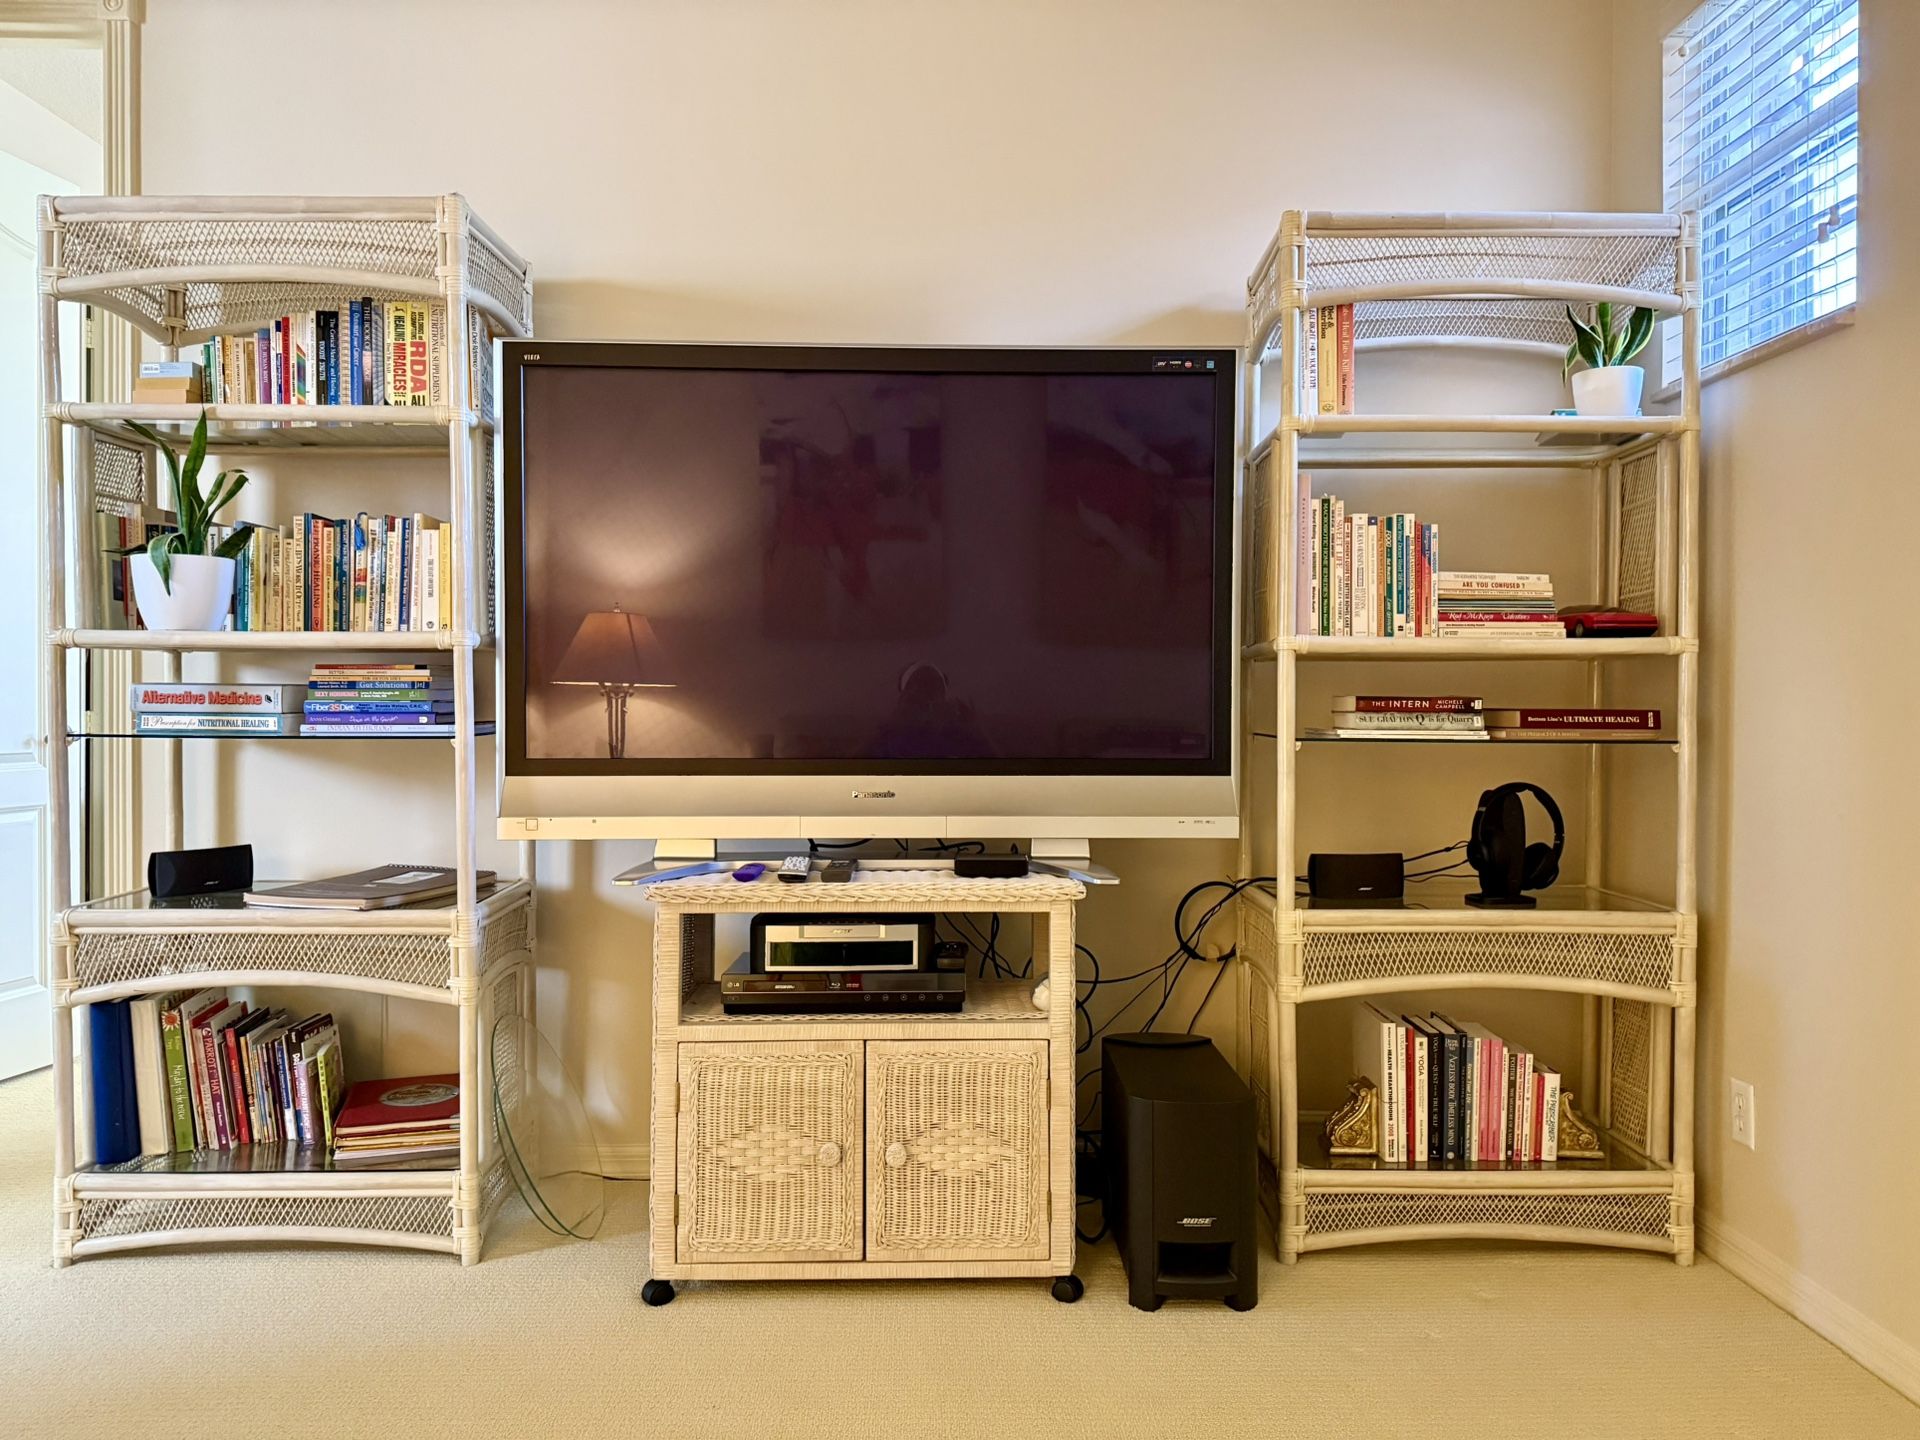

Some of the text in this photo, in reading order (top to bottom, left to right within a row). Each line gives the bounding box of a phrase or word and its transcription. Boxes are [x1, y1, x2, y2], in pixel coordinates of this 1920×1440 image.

[363, 306, 371, 321] THE
[363, 321, 372, 340] BOOK
[393, 315, 407, 391] HEALING MIRACLES
[431, 308, 441, 402] NUTRITIONAL SUPPLEMENTS
[410, 340, 427, 394] RDA
[313, 570, 321, 609] HEALING
[375, 681, 408, 689] Solutions
[141, 690, 262, 705] Alternative Medicine
[1389, 700, 1430, 708] INTERN
[151, 716, 270, 729] Prescription for NUTRITIONAL HEALING
[1415, 713, 1425, 725] Q
[1436, 714, 1447, 722] for
[1447, 714, 1475, 724] Quarry
[851, 790, 896, 799] Panasonic
[203, 1037, 217, 1069] PARROT
[210, 1079, 221, 1095] HAT
[1447, 1054, 1458, 1145] AGELESS BODY TIMELESS MIND
[1181, 1217, 1213, 1225] BOSE
